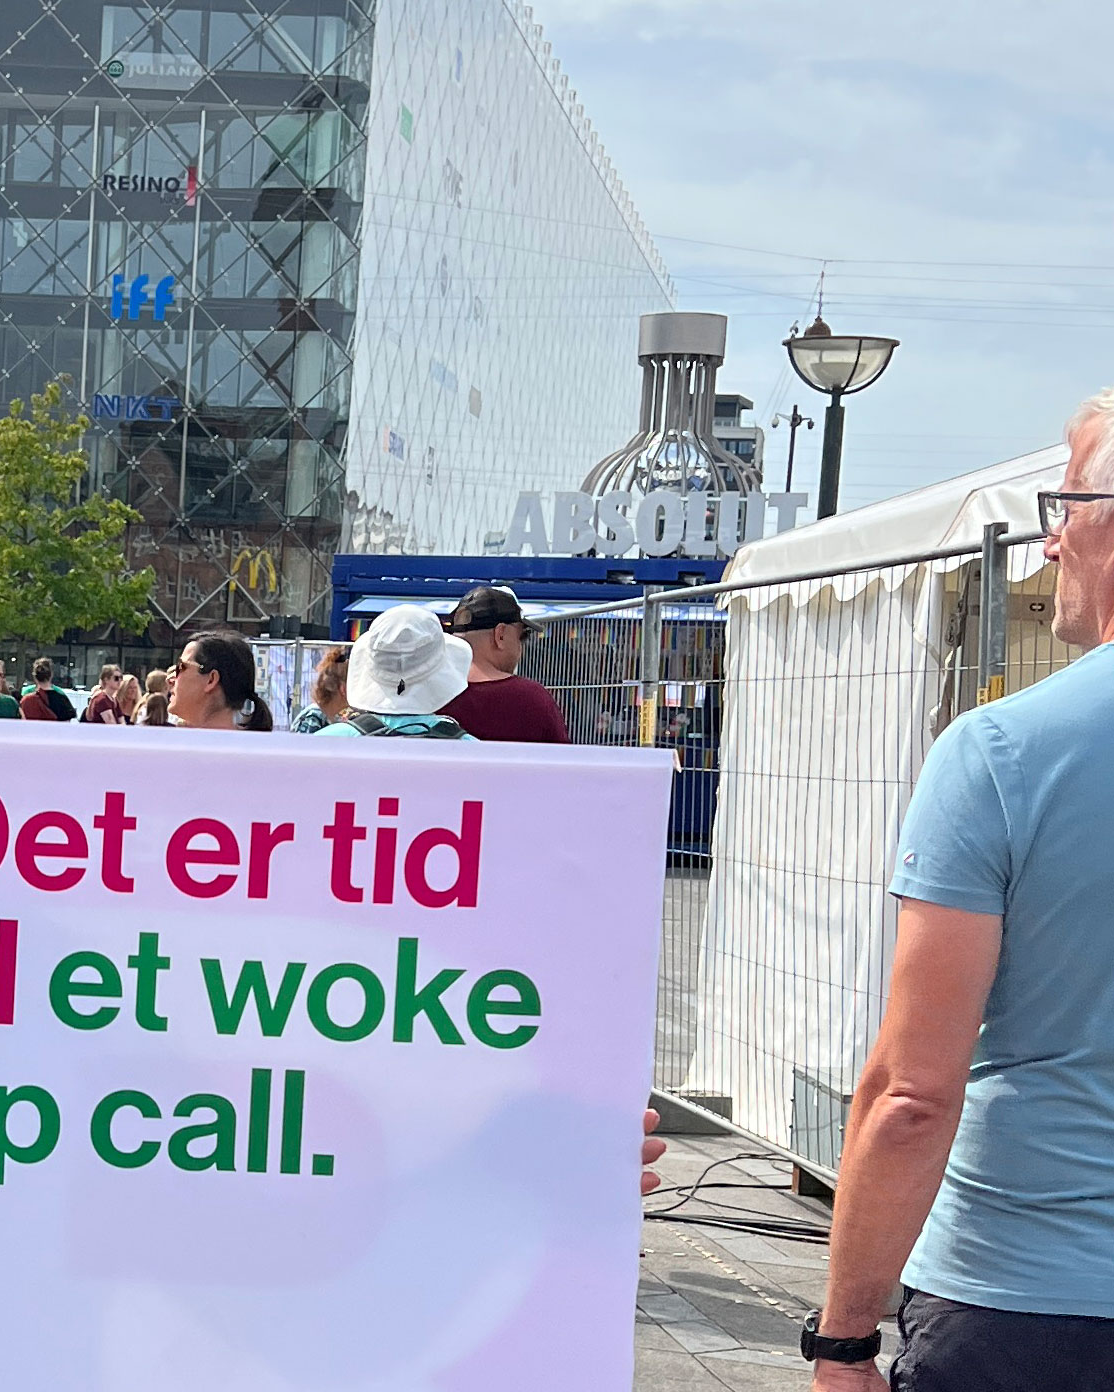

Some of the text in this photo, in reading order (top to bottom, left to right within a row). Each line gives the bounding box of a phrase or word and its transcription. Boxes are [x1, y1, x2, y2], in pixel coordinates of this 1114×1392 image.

[128, 64, 204, 78] JULIANA
[103, 174, 180, 193] RESINO
[93, 394, 183, 420] NKT
[503, 490, 808, 557] ABSOLUT
[166, 818, 294, 899] er
[323, 798, 483, 908] tid
[50, 933, 170, 1031] et
[201, 938, 541, 1048] woke
[91, 1069, 334, 1175] call.
